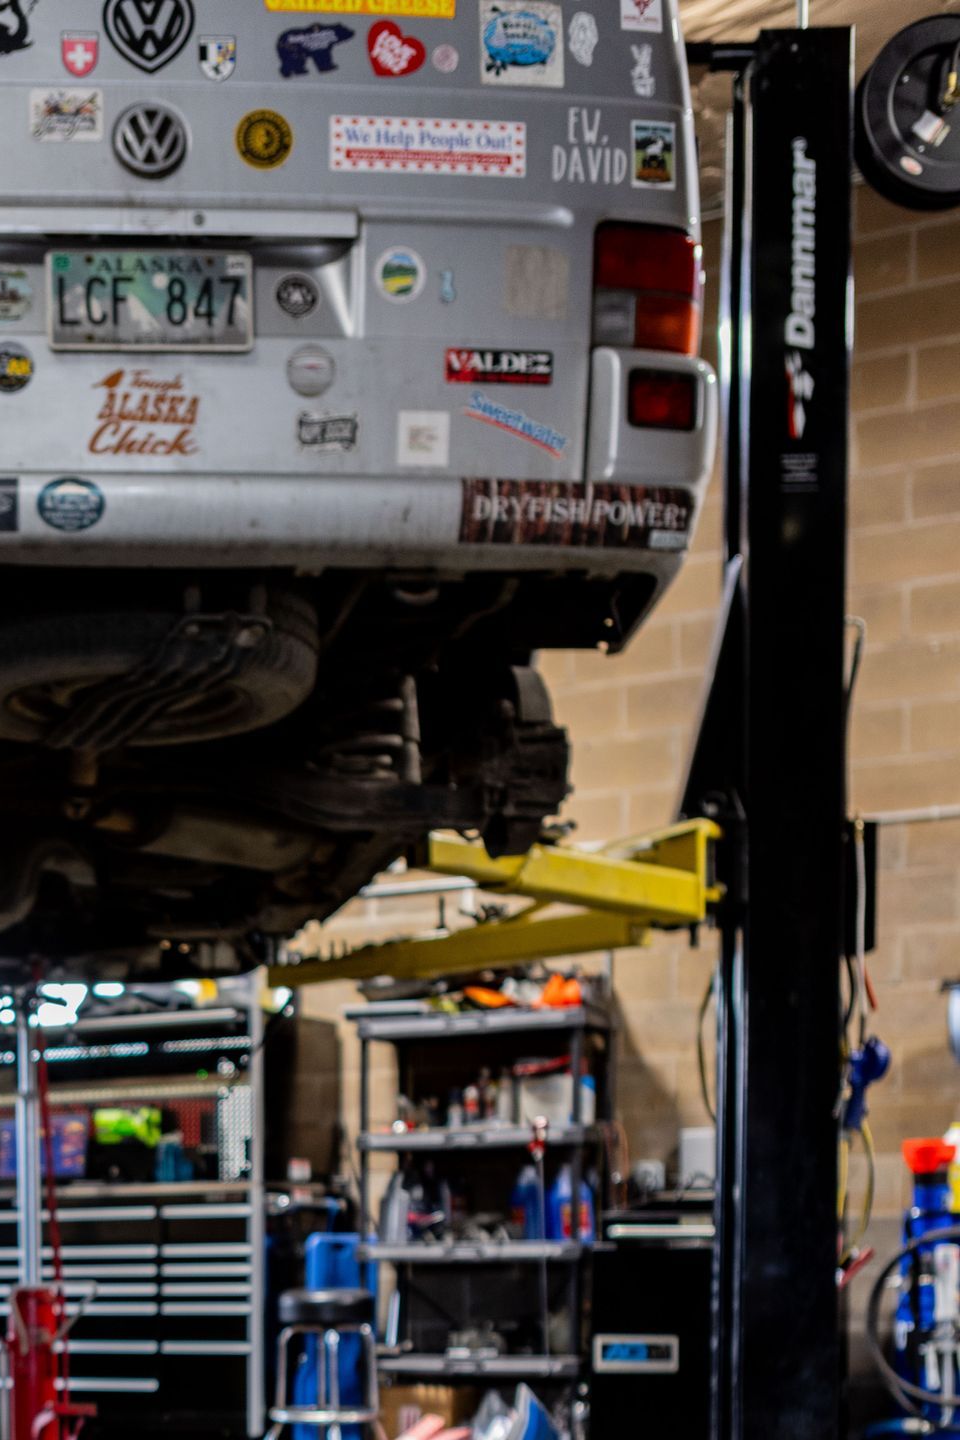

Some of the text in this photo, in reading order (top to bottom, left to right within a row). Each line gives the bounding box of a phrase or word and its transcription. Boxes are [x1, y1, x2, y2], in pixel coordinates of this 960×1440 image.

[116, 104, 186, 172] VW
[344, 127, 513, 153] We Help People Out!
[551, 144, 628, 184] DAVID
[96, 257, 203, 273] ALASKA
[784, 150, 817, 350] Dannmar
[58, 275, 242, 327] LCF 847
[448, 351, 552, 374] VALDEZ
[96, 391, 200, 424] ALASKA
[470, 390, 567, 451] Sweetwater
[87, 421, 204, 456] Chick
